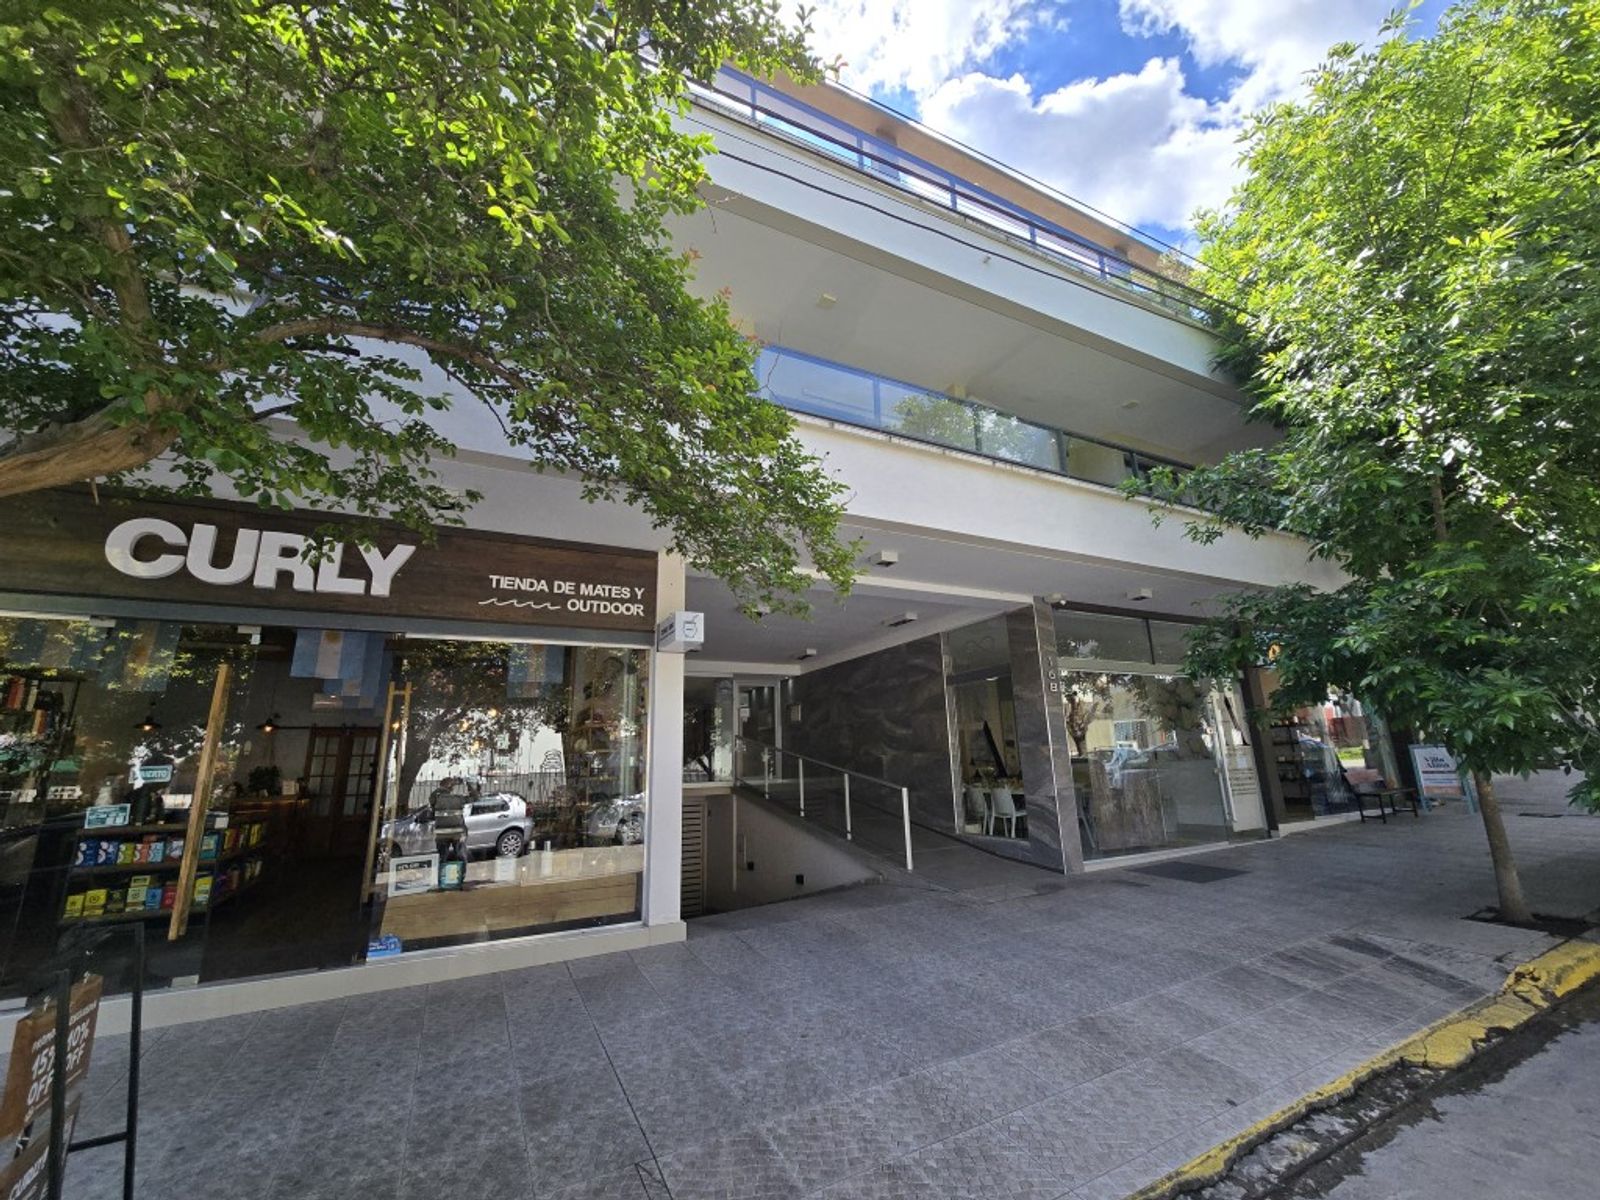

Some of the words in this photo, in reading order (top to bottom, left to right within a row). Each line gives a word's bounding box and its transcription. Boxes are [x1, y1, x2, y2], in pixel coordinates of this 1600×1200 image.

[104, 517, 416, 597] CURLY
[489, 574, 549, 593] TIENDA
[553, 580, 577, 595] DE
[579, 583, 631, 598] MATES
[634, 587, 645, 600] Y
[567, 599, 645, 616] OUTDOOR
